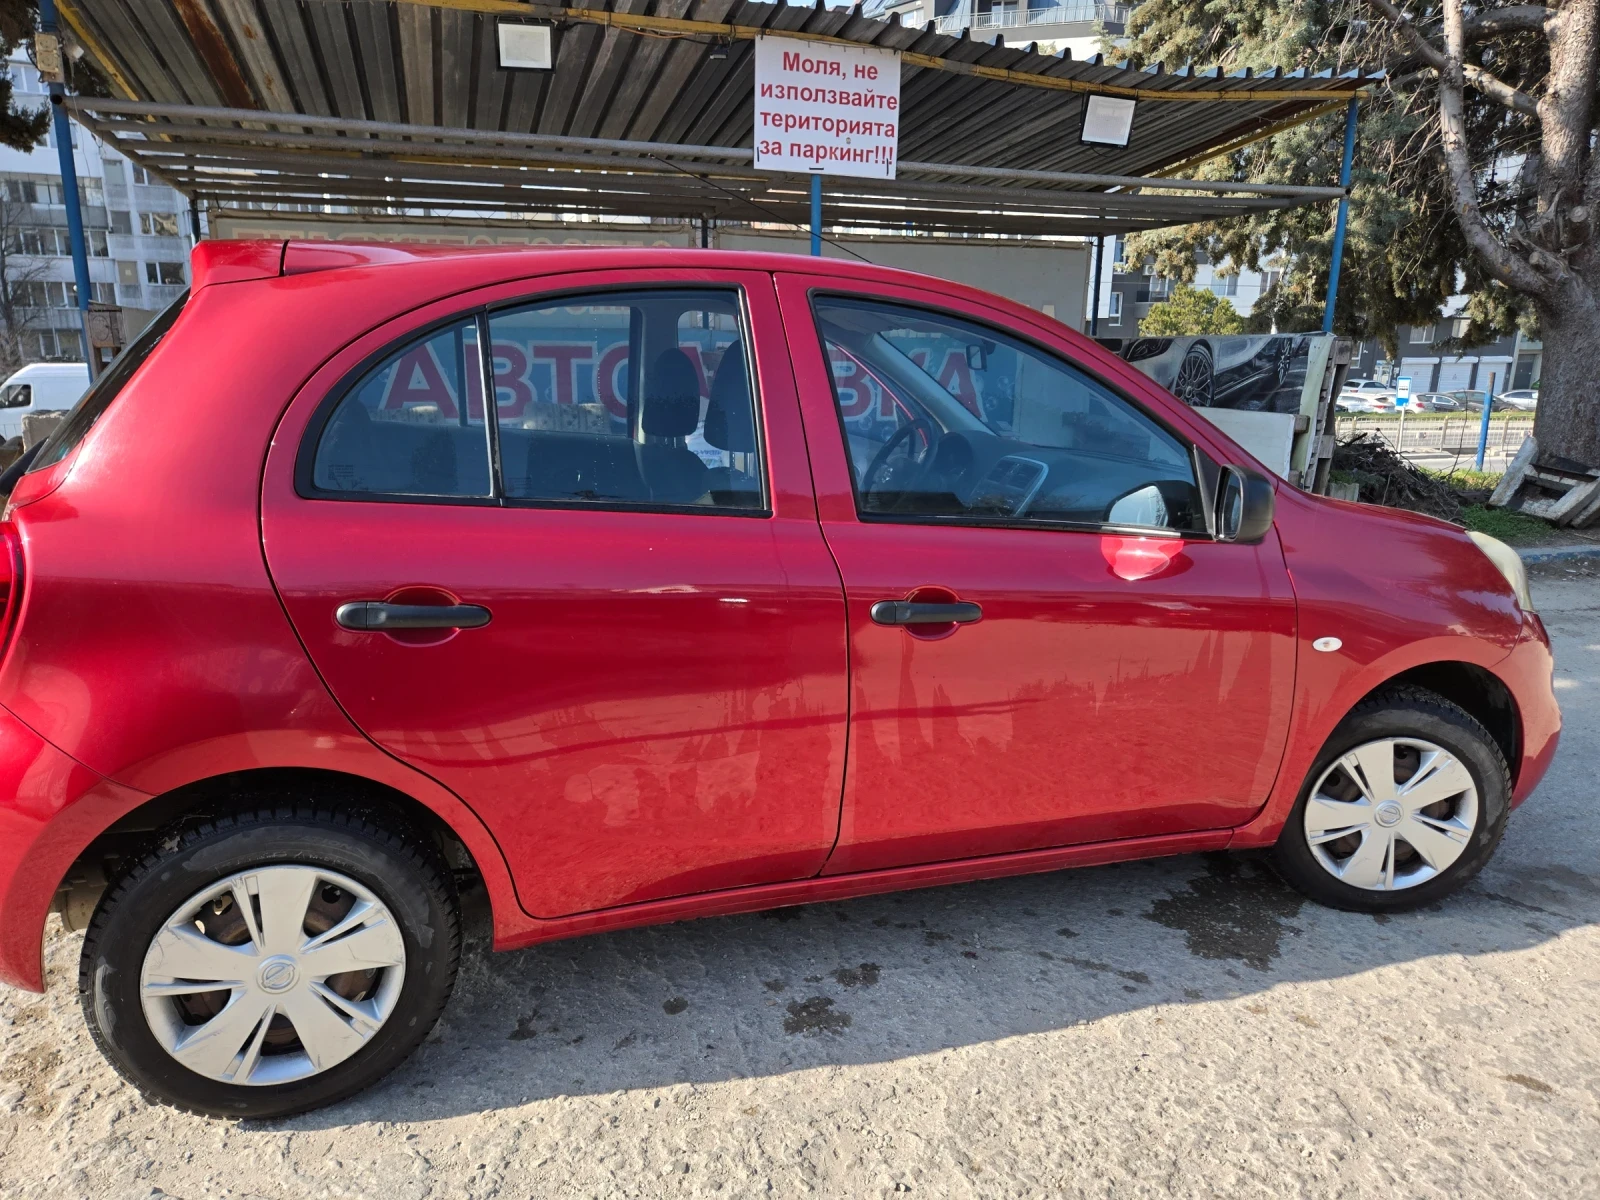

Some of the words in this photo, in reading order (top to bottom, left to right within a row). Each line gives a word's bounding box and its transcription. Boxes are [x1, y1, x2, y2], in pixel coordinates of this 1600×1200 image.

[783, 52, 847, 80] Моля,
[854, 64, 879, 80] не
[760, 83, 898, 110] използвайте
[760, 111, 895, 137] територията
[760, 139, 782, 156] за
[789, 143, 894, 165] паркинг!!!
